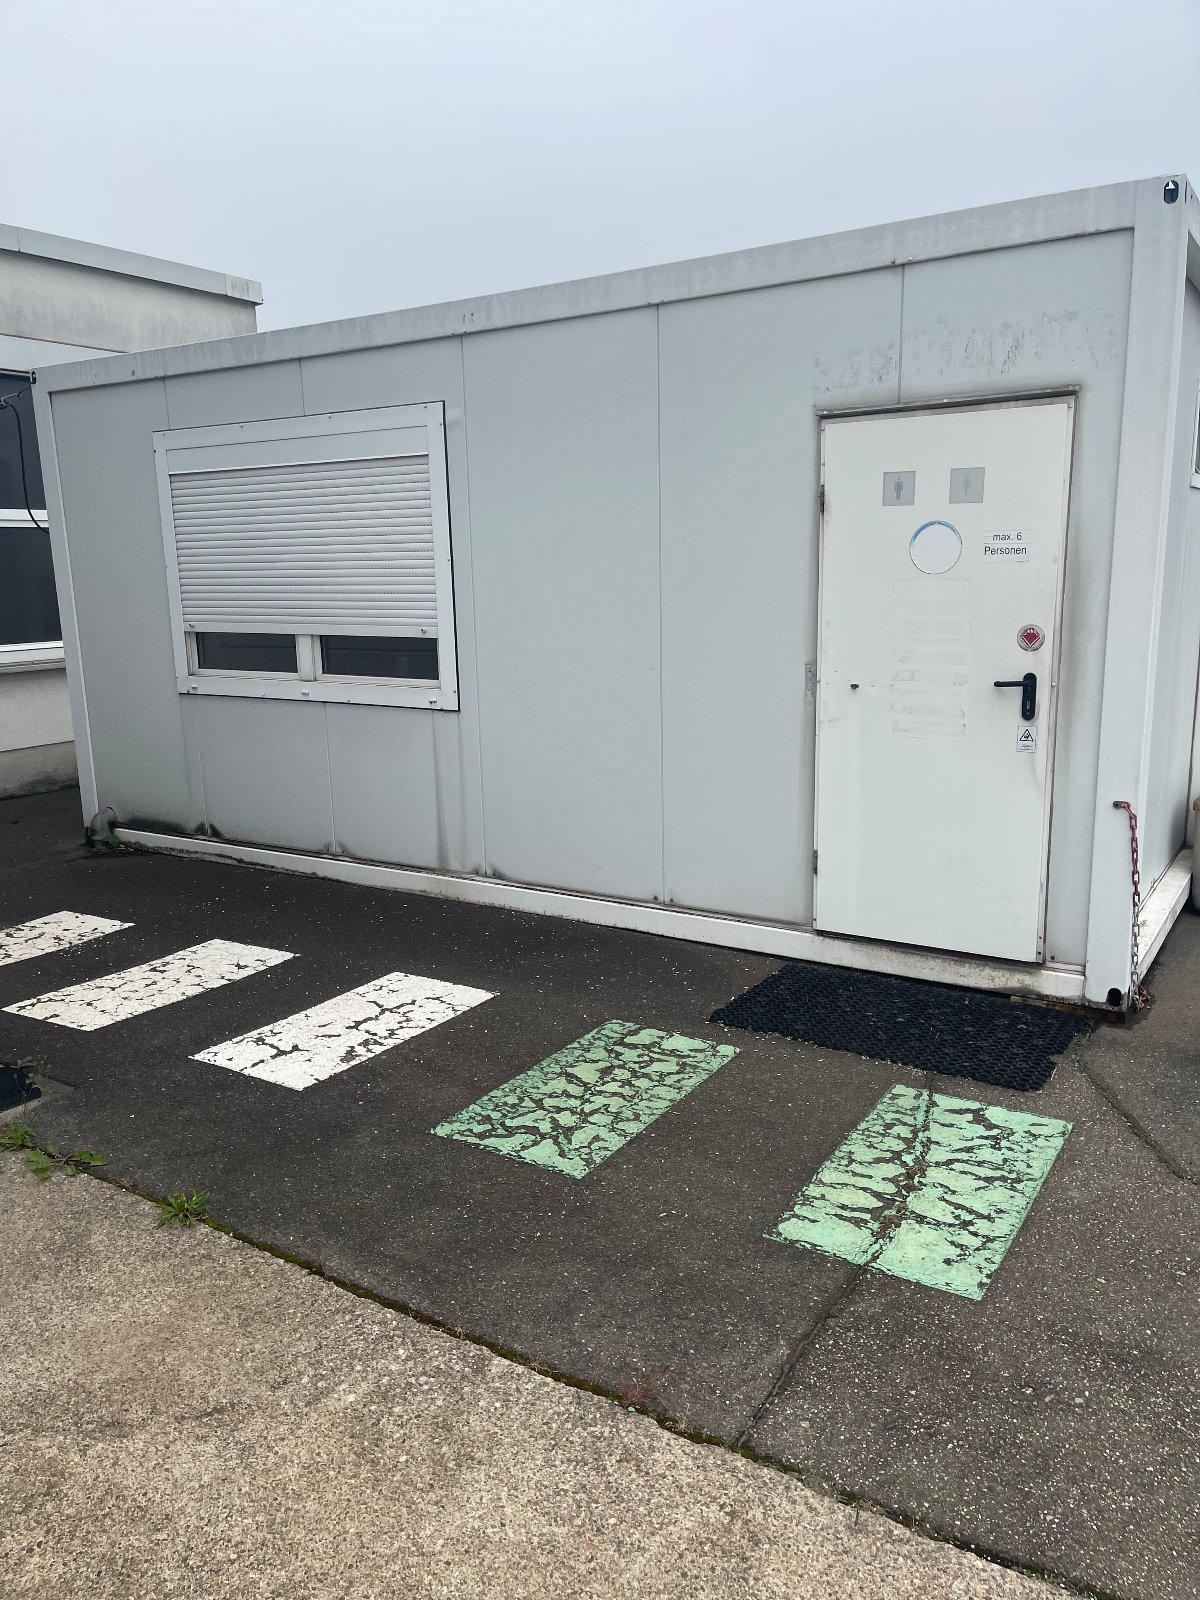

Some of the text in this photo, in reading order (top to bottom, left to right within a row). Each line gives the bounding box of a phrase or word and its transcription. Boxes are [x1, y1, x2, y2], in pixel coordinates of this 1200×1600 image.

[992, 531, 1023, 541] max. 6
[984, 546, 1027, 555] Personen
